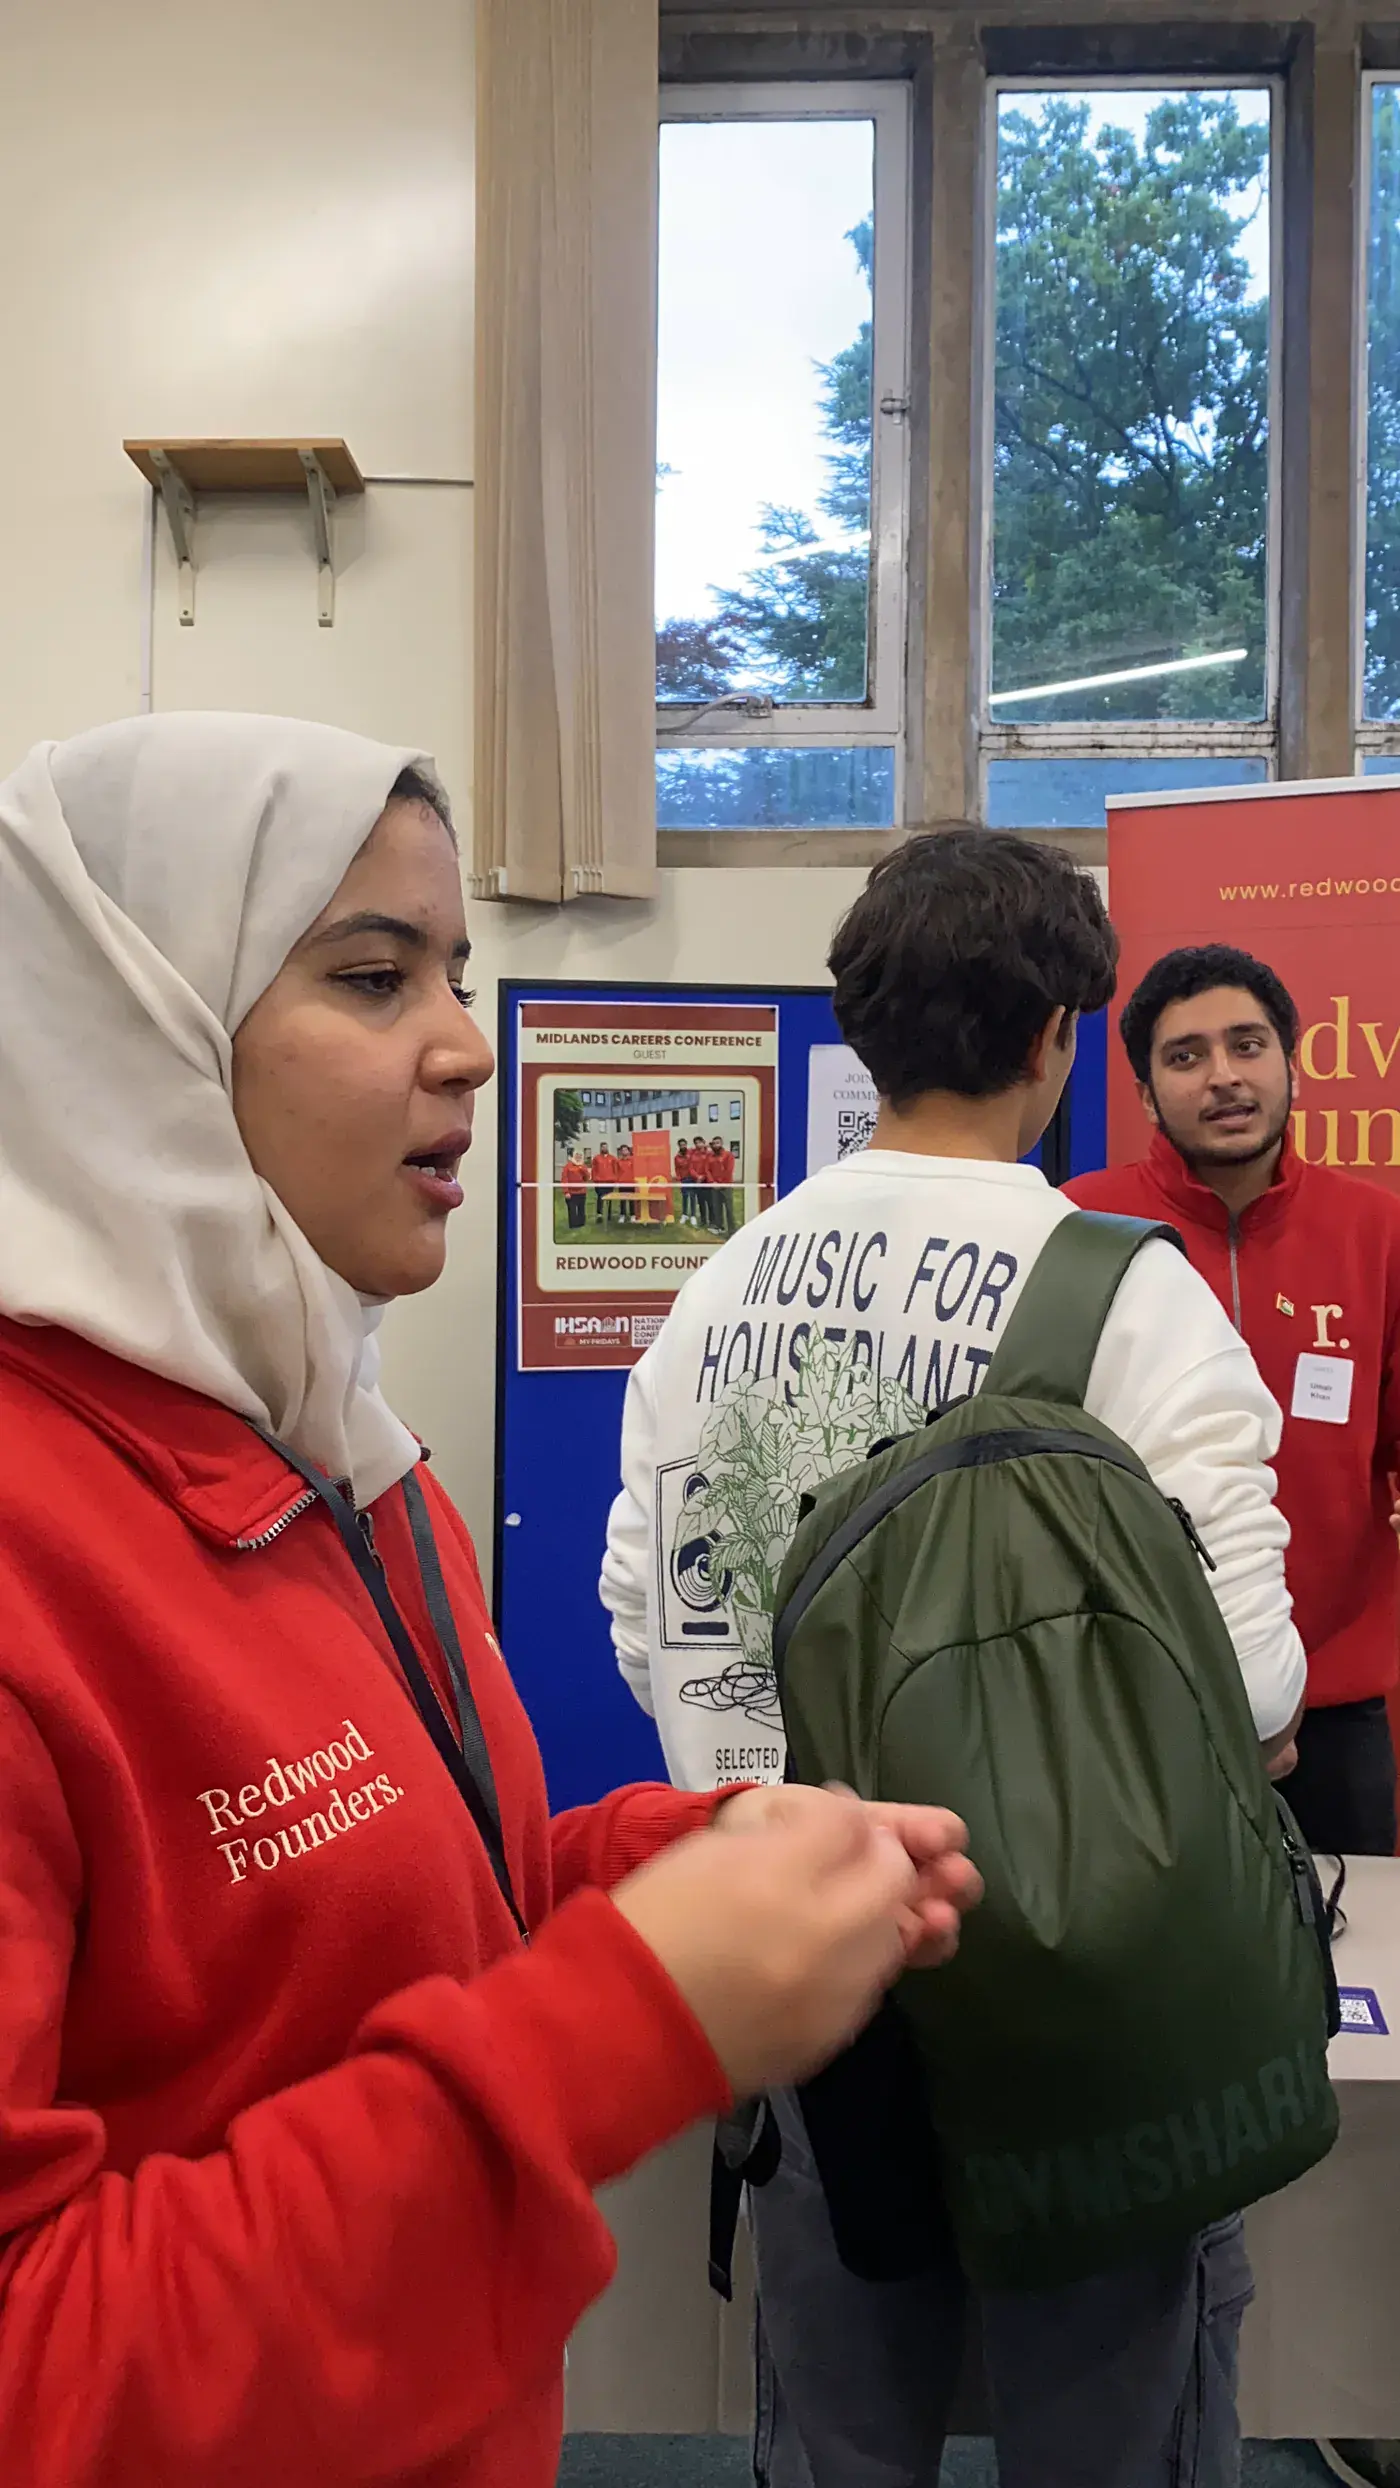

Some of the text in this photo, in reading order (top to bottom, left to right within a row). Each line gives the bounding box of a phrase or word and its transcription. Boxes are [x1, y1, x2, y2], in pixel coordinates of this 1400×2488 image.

[536, 1033, 762, 1047] MIDLANDS CAREERS CONFERENCE
[633, 1049, 667, 1060] GUEST
[556, 1256, 647, 1270] REDWOOD
[742, 1229, 1018, 1332] MUSIC FOR
[715, 1747, 779, 1770] SELECTED
[196, 1719, 375, 1835] Redwood
[217, 1773, 405, 1884] Founders.
